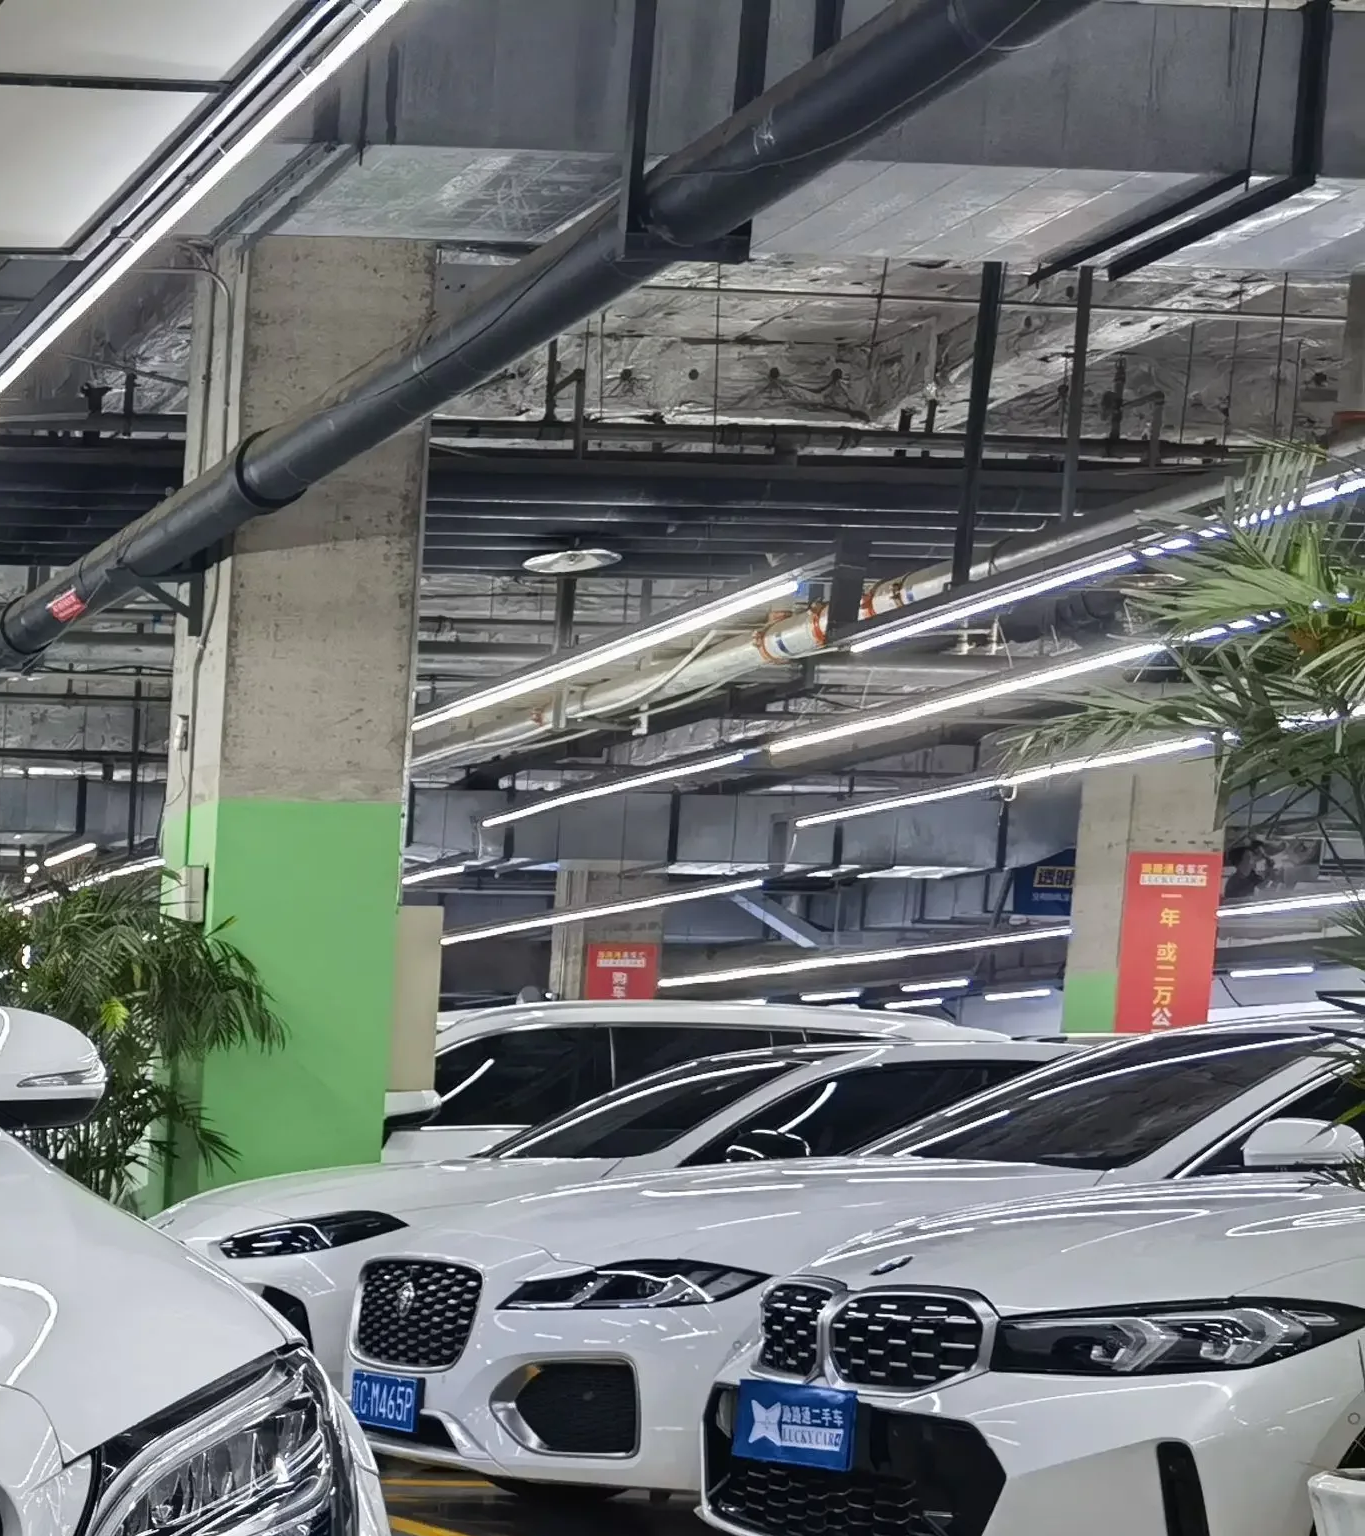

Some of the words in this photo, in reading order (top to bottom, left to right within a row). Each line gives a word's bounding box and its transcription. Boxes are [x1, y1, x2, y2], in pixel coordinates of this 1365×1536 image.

[1151, 893, 1183, 1032] 一年或二万公
